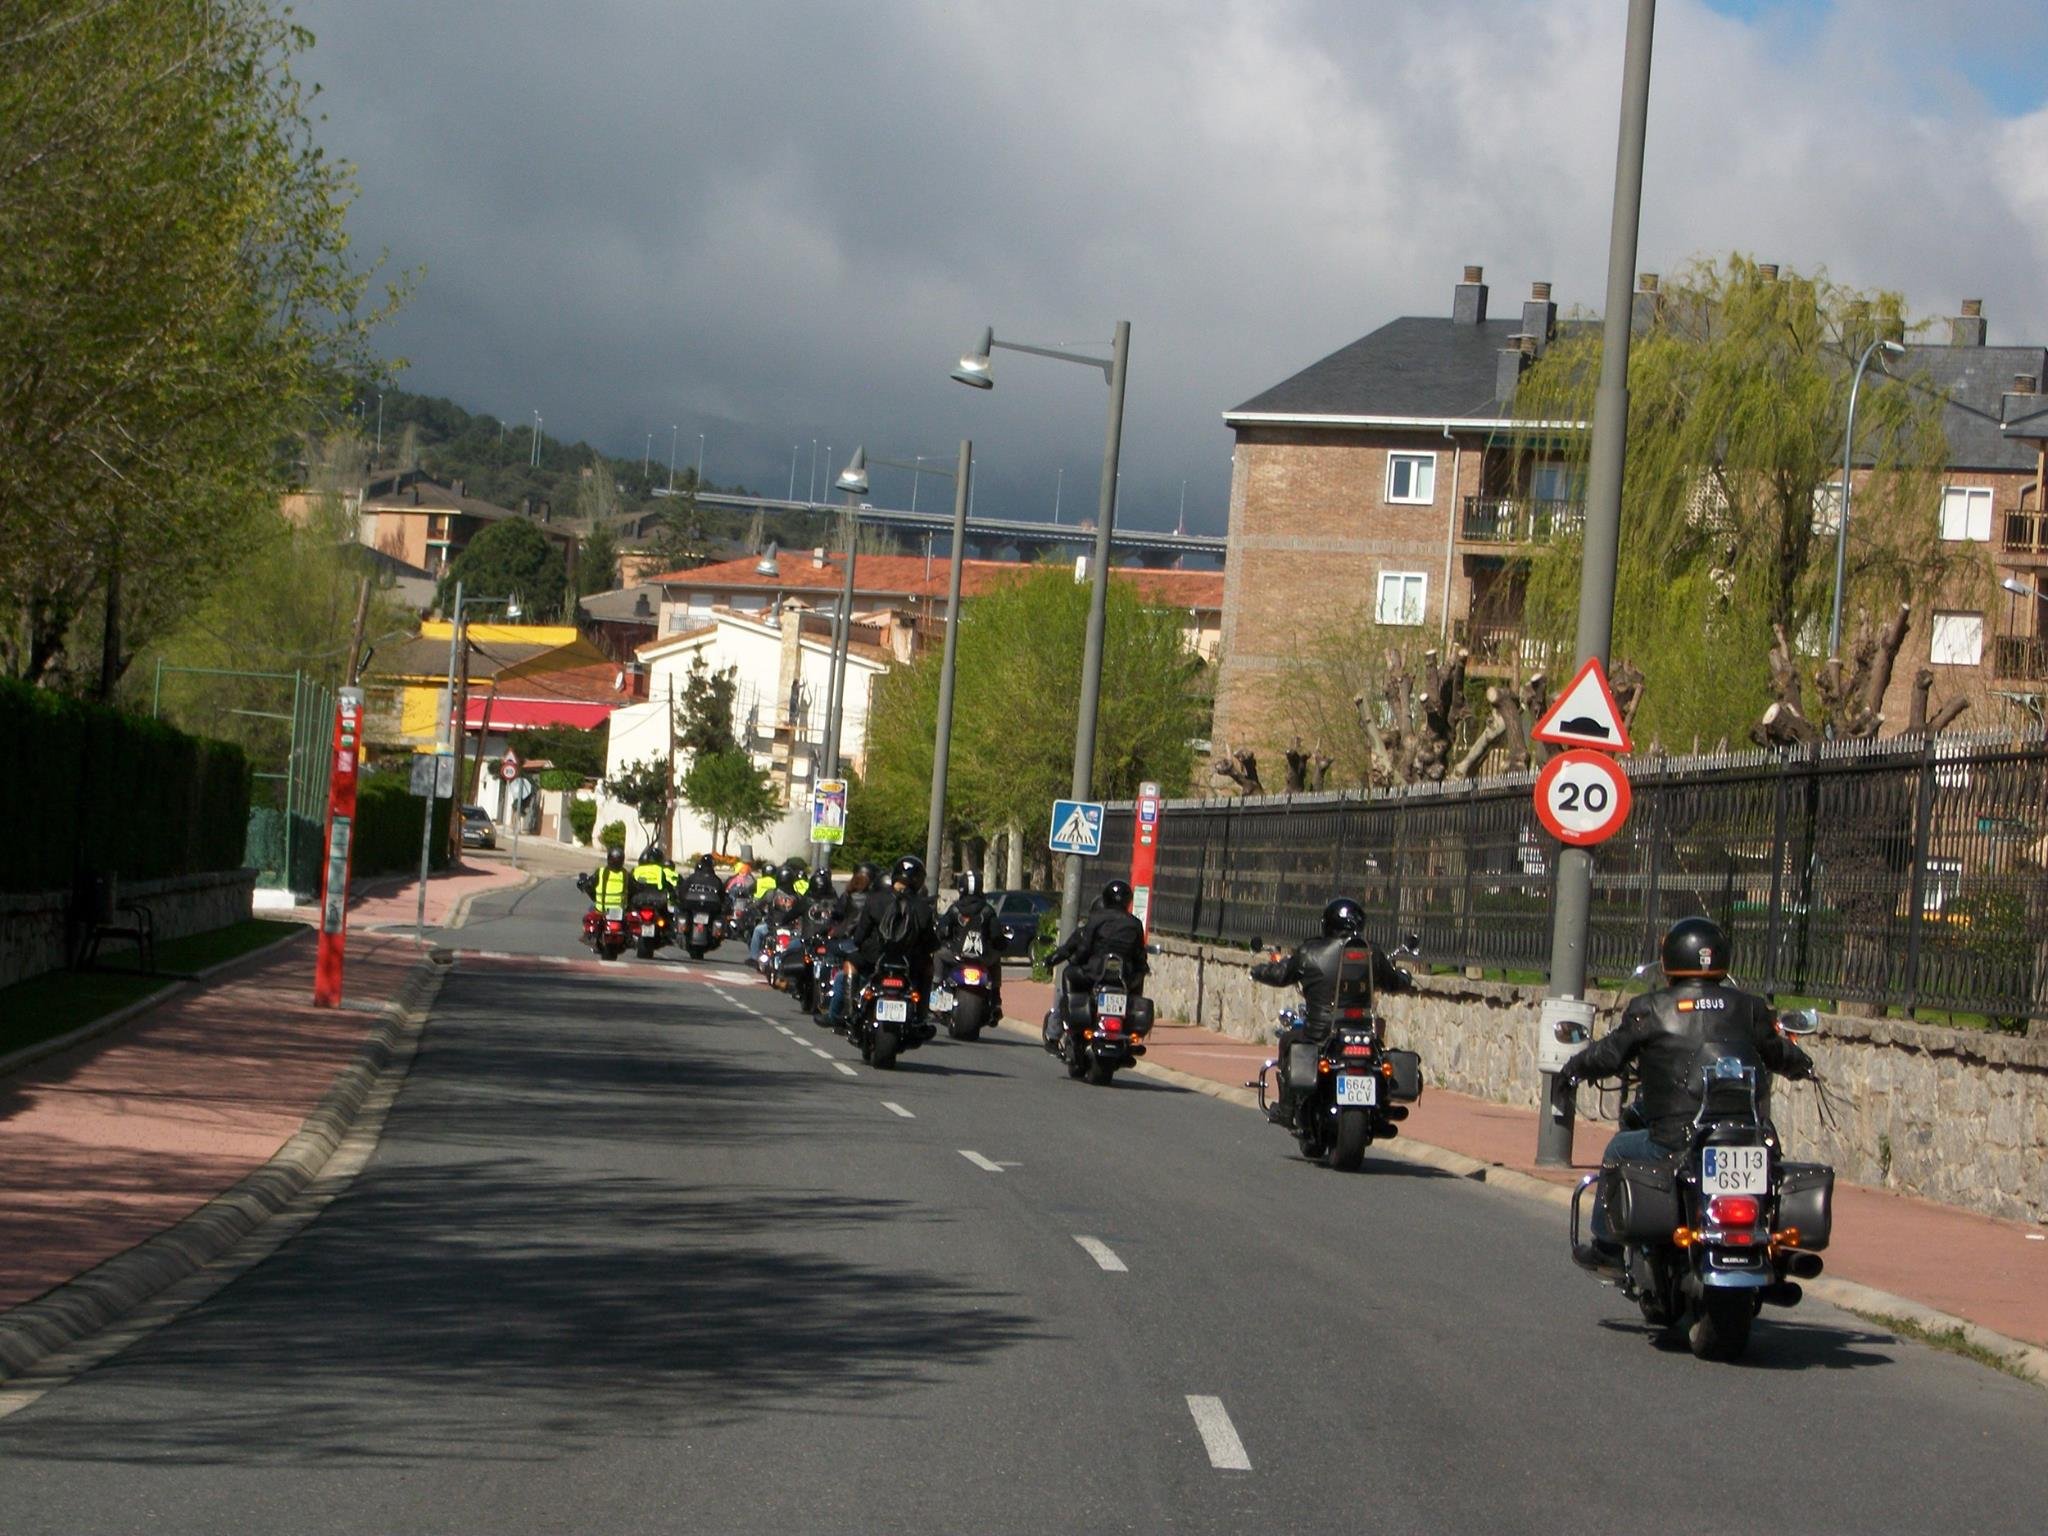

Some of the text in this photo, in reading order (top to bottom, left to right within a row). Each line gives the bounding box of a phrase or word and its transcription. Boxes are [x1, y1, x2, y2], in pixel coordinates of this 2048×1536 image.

[1557, 782, 1608, 812] 20
[1694, 998, 1725, 1010] JESUS
[1346, 1079, 1372, 1091] 6642
[1347, 1090, 1371, 1102] GCV
[1718, 1151, 1763, 1169] 3113
[1718, 1171, 1752, 1189] GSY
